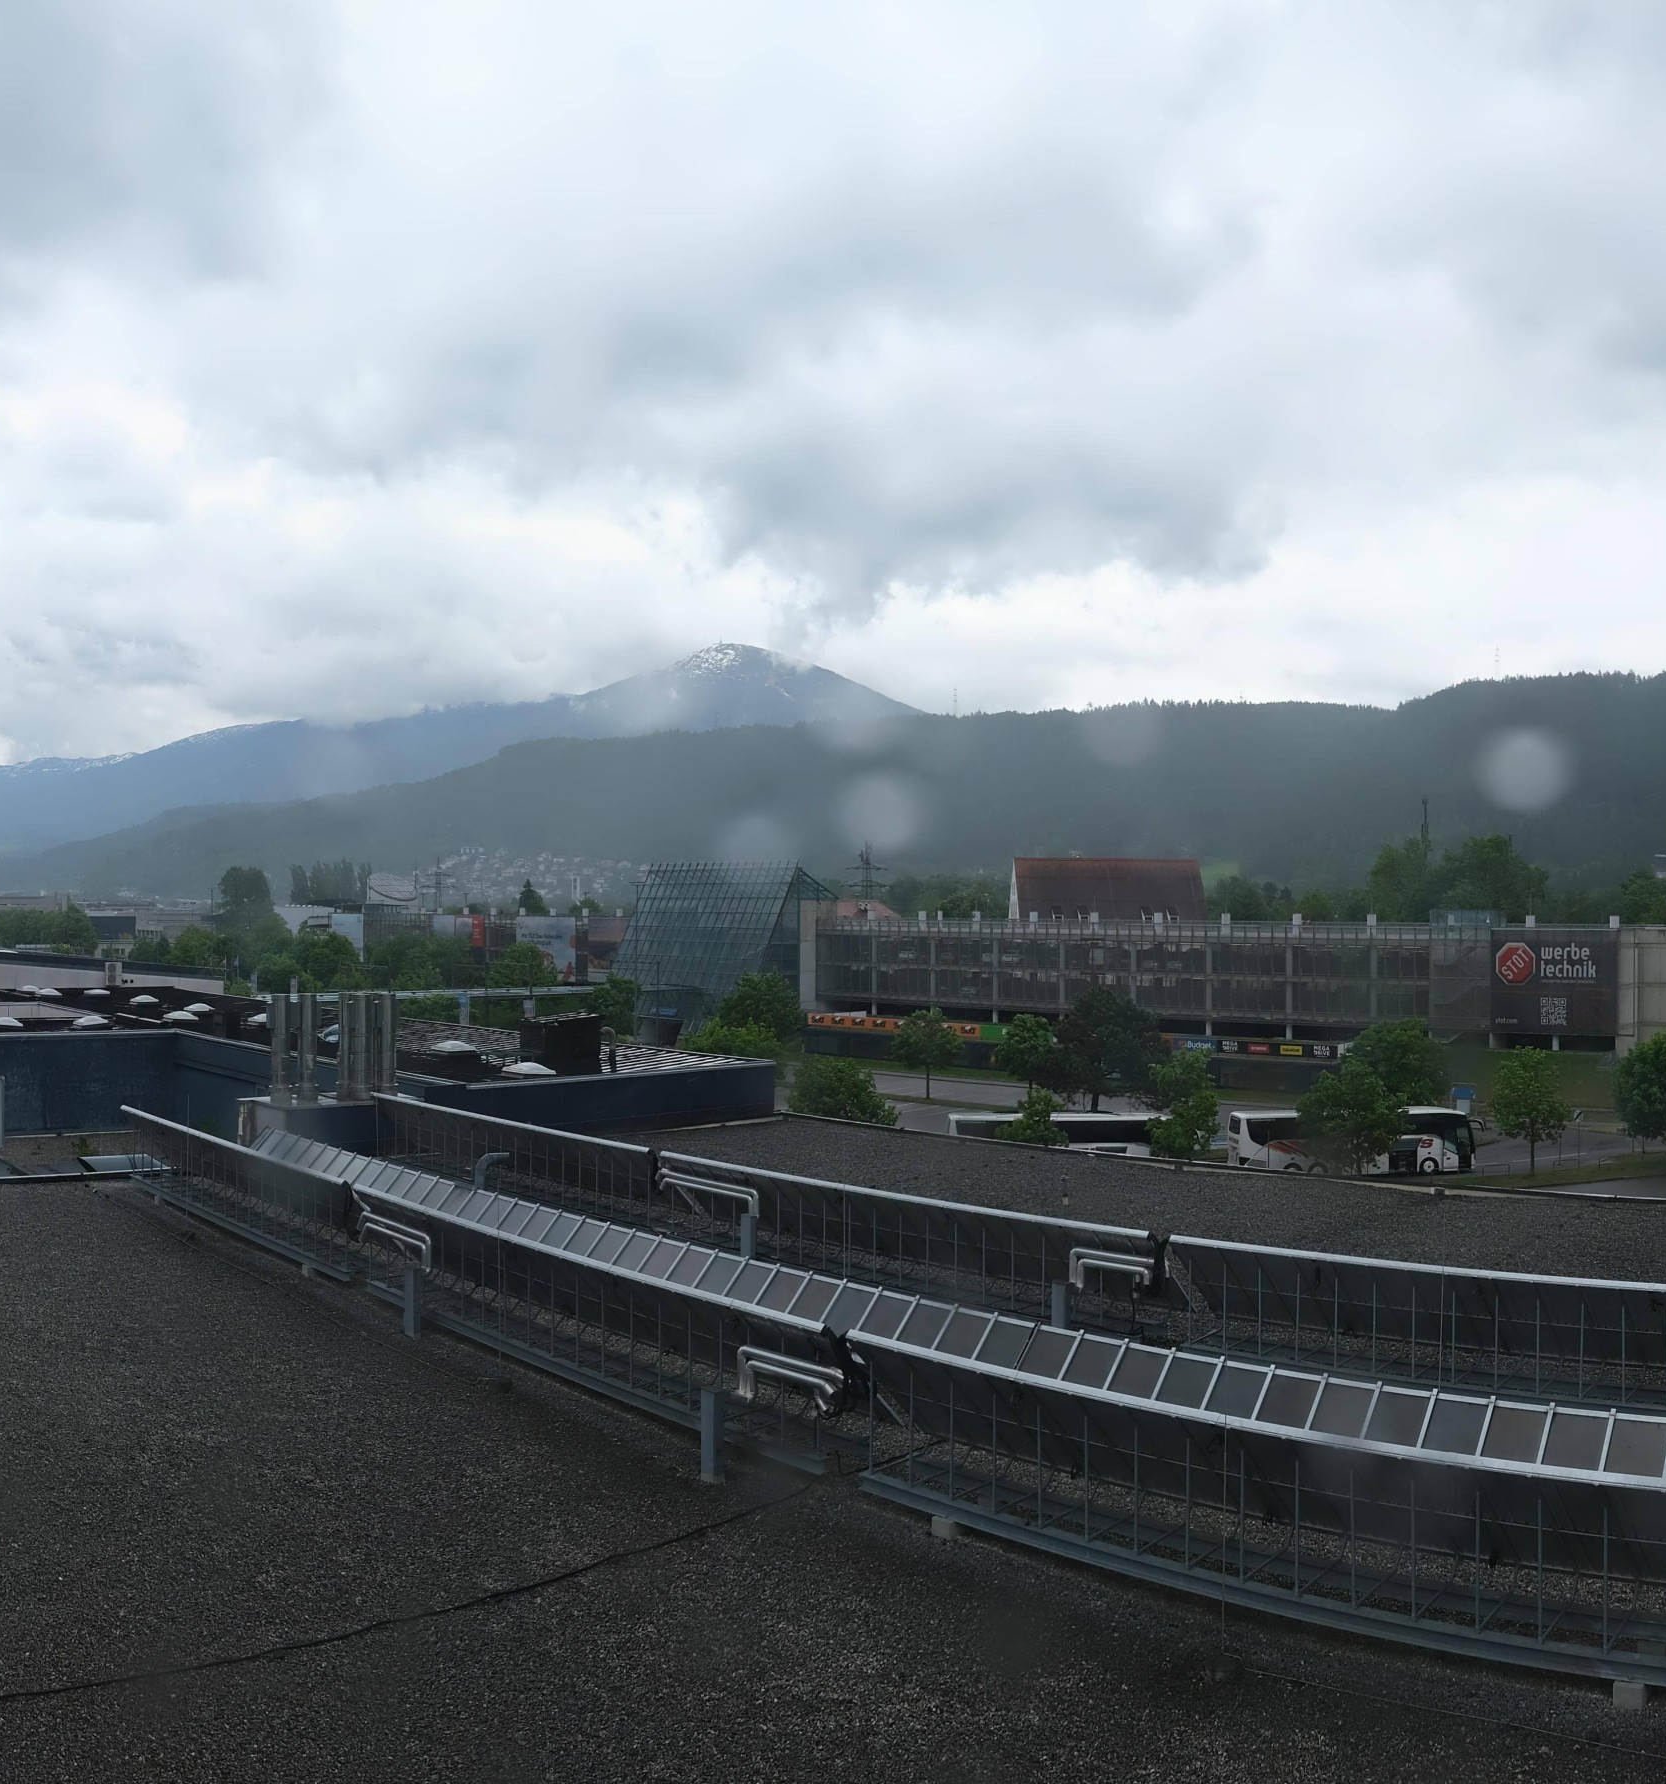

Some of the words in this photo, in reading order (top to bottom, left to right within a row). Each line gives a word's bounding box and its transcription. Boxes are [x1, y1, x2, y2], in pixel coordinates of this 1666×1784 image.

[1540, 942, 1590, 960] werbe
[1501, 948, 1530, 980] STOT
[1540, 960, 1596, 978] technik
[1187, 1040, 1212, 1050] Budget
